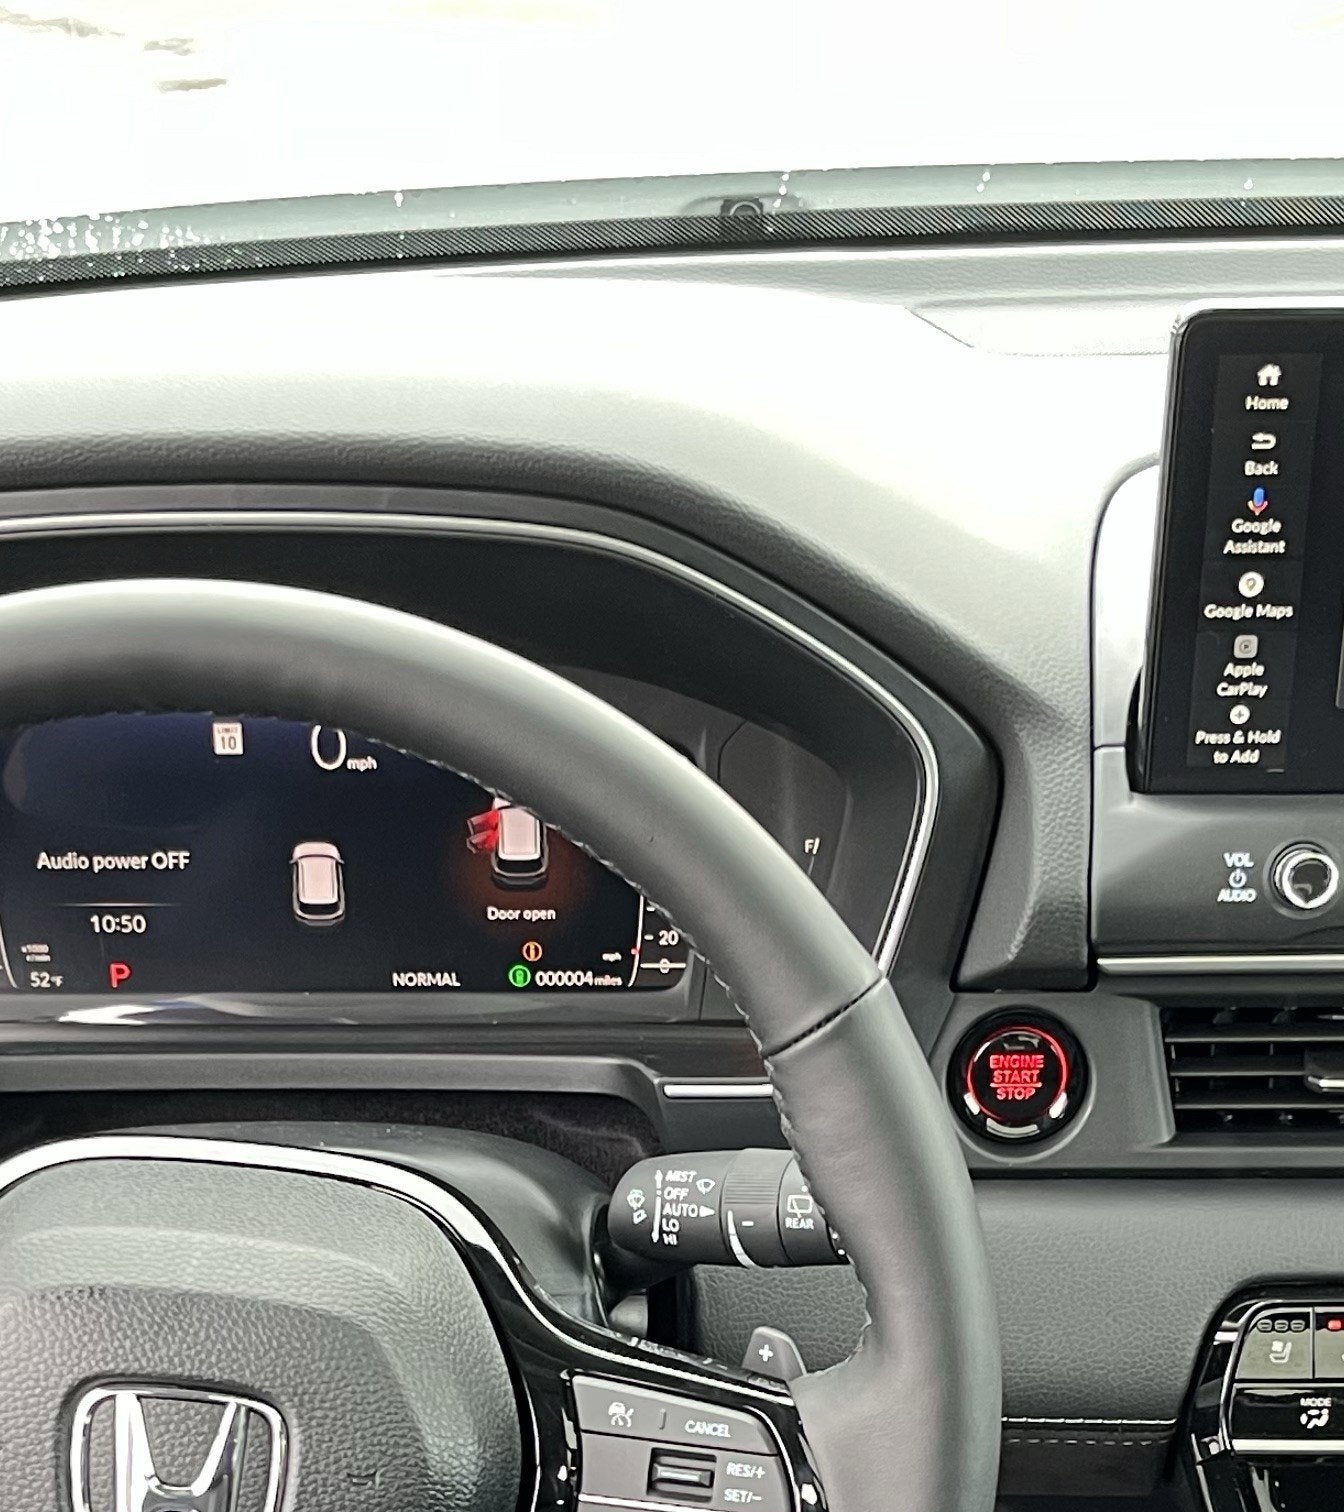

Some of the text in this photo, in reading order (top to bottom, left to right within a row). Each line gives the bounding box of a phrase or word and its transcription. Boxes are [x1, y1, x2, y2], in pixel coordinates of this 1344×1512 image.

[1244, 396, 1289, 410] Home
[1244, 460, 1278, 476] Back
[1231, 518, 1282, 535] Google
[1223, 539, 1286, 554] Assistant
[1204, 603, 1294, 620] Google Maps
[1223, 662, 1265, 678] Apple
[1216, 682, 1268, 698] CarPlay
[220, 736, 237, 750] 10
[1195, 729, 1282, 744] Press & Hold
[347, 756, 378, 772] mph
[1213, 749, 1260, 764] to Add
[37, 852, 190, 873] Audio power OFF
[1223, 853, 1254, 868] VOL
[1217, 889, 1257, 902] AUDIO
[487, 907, 556, 923] Door open
[90, 914, 146, 934] 10:50
[659, 931, 679, 945] 20
[110, 963, 131, 987] P
[392, 973, 461, 986] NORMAL
[535, 971, 623, 986] 000004 miles
[989, 1054, 1044, 1069] ENGINE
[993, 1070, 1040, 1083] START
[996, 1088, 1036, 1100] STOP
[665, 1170, 698, 1183] MIST
[664, 1187, 689, 1200] OFF
[662, 1204, 698, 1218] AUTO
[662, 1219, 680, 1232] LO
[786, 1217, 814, 1230] REAR
[663, 1234, 678, 1246] HI
[1301, 1398, 1332, 1408] MODE
[685, 1420, 731, 1438] CANCEL
